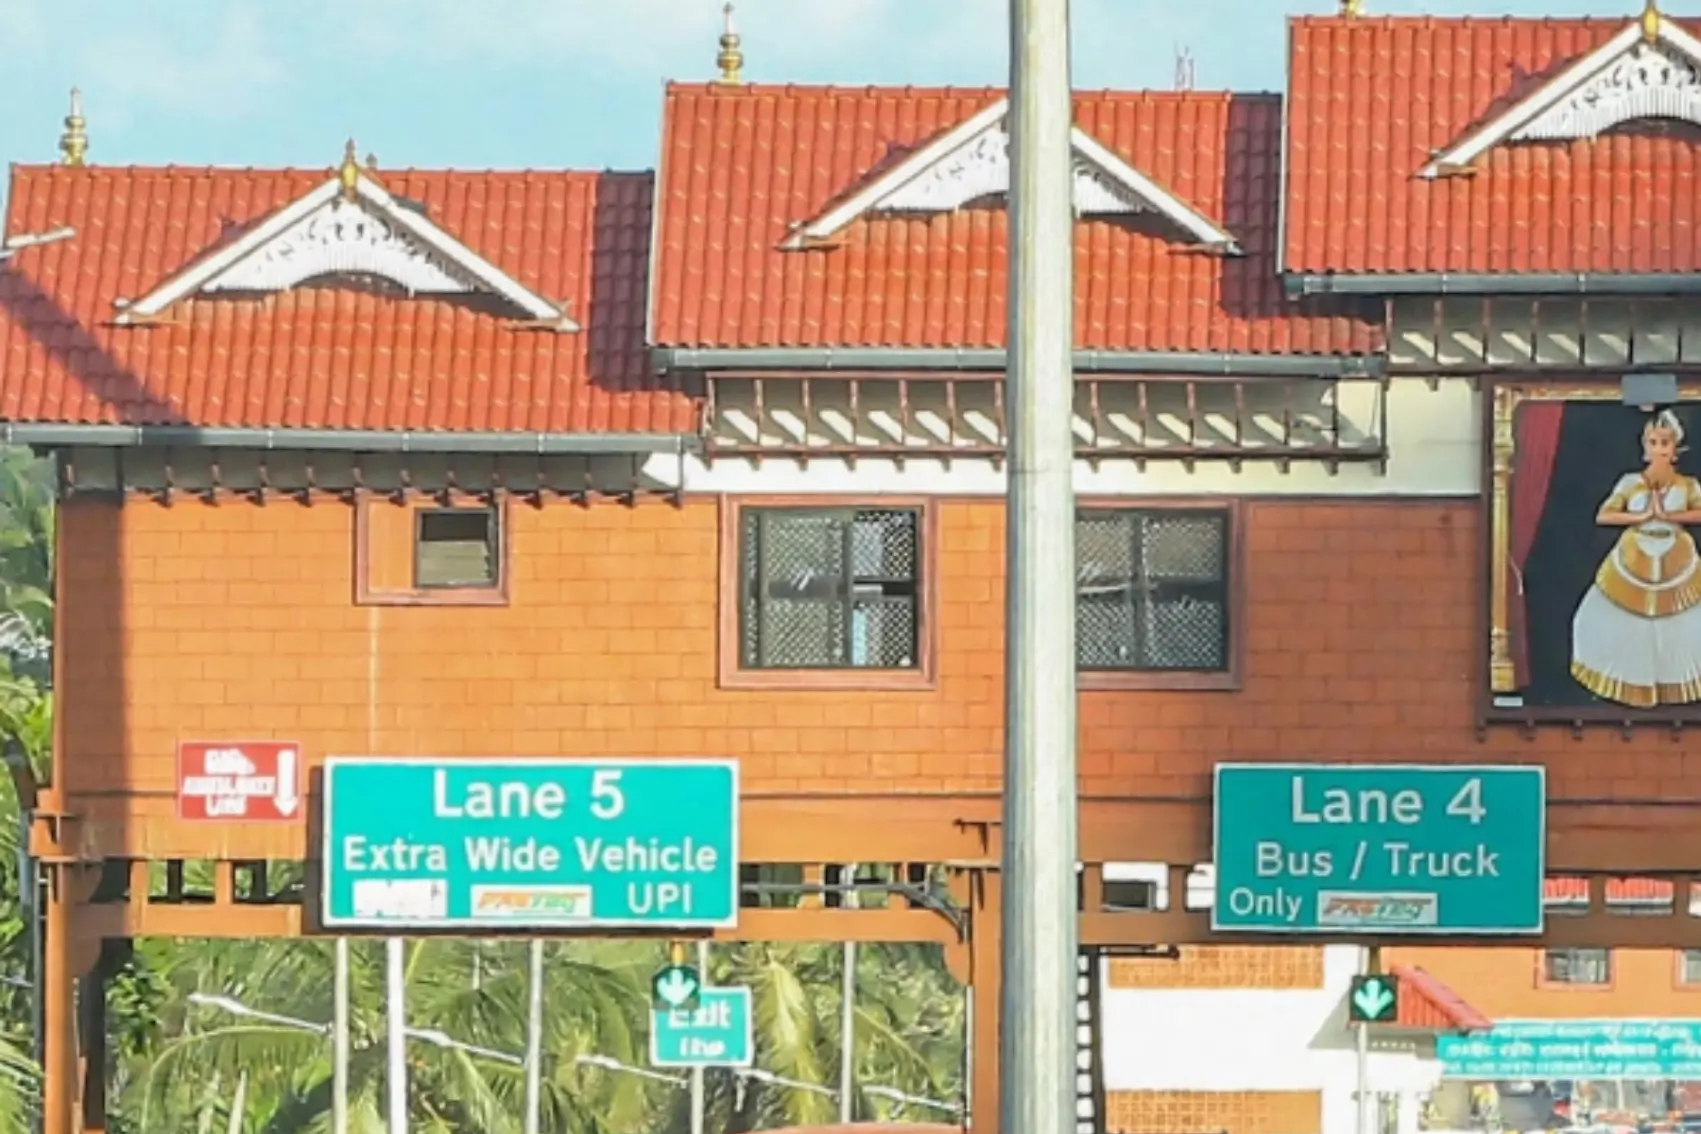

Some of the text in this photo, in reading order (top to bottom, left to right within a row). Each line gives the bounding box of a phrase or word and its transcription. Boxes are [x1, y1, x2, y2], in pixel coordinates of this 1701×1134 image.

[433, 769, 625, 819] Lane 5
[1292, 777, 1486, 824] Lane 4
[344, 837, 717, 871] Extra Wide Vehicle
[1256, 843, 1499, 879] Bus / Truck
[626, 881, 692, 914] UPI
[1229, 889, 1302, 923] Only
